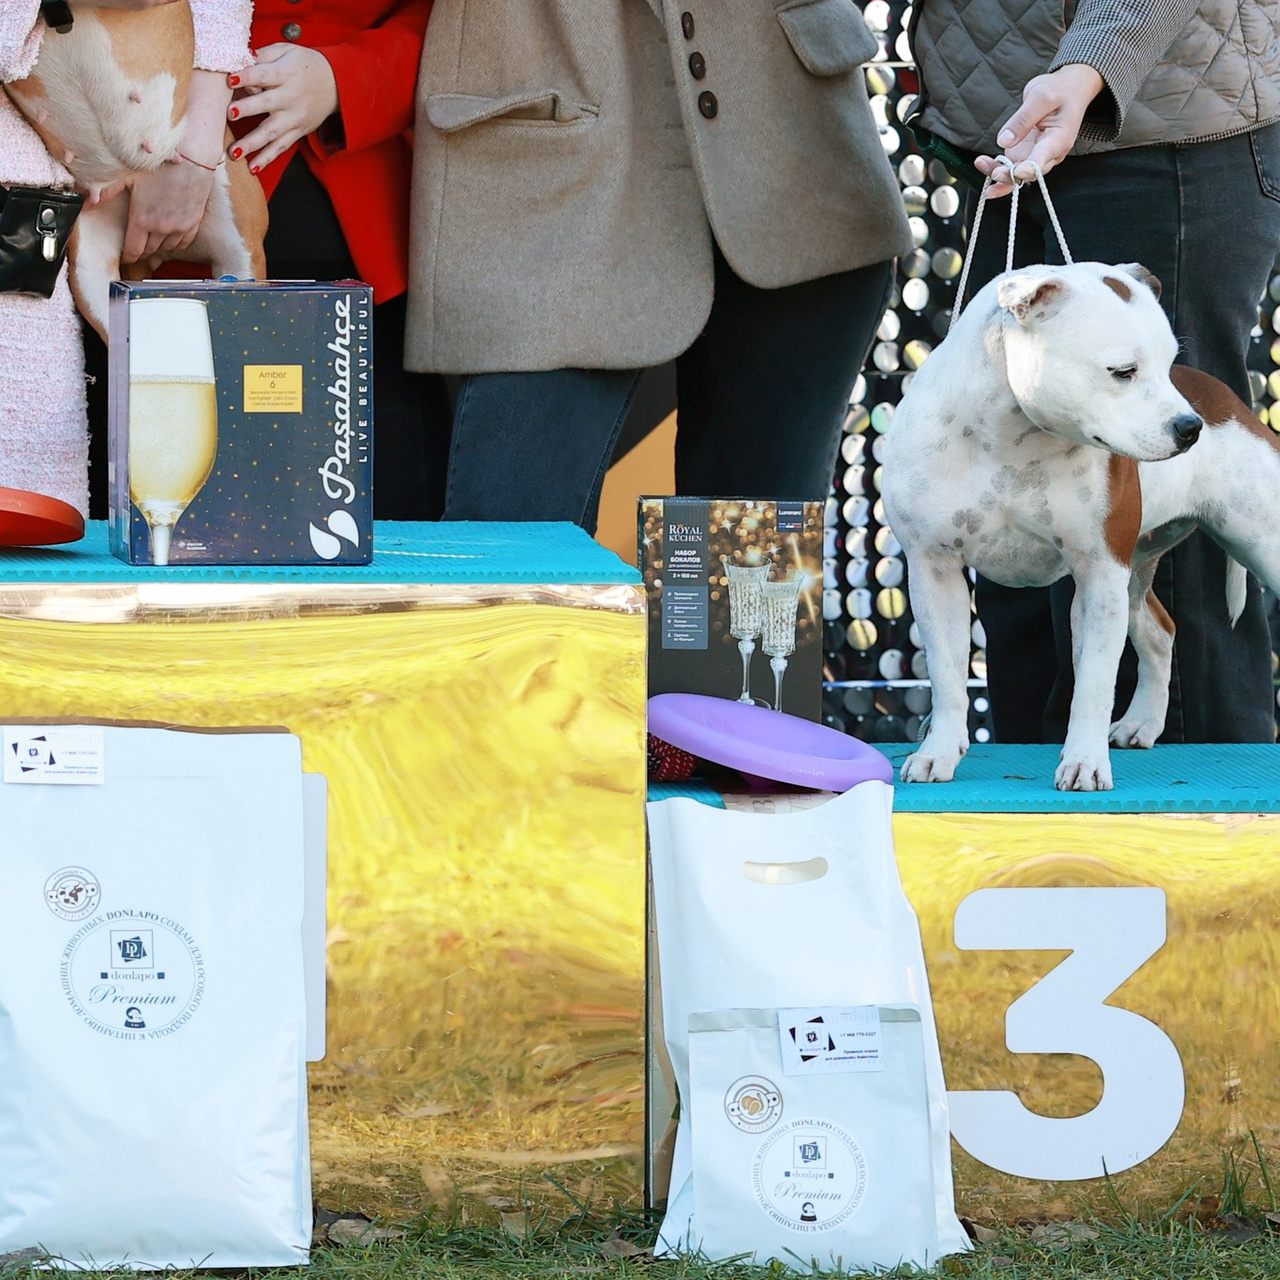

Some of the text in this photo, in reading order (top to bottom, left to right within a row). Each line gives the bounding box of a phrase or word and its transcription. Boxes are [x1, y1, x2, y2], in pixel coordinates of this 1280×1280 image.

[259, 371, 287, 379] Amber
[358, 297, 368, 463] LIVE BEAUTIFUL
[269, 380, 276, 389] 6
[669, 524, 703, 535] ROYAL
[669, 534, 702, 542] KÜCHEN
[60, 909, 206, 1041] DONLAPO СОЗДАН ДЛЯ ОСОБОГО ПОДХОДА К ПИТАНИЮ ДОМАШНИХ ЖИВОТНЫХ
[111, 971, 155, 982] donlapo
[88, 984, 177, 1005] Premium
[947, 887, 1186, 1181] 3
[791, 1119, 833, 1130] DONLAPO
[792, 1170, 826, 1180] donlapo
[774, 1181, 842, 1201] Premium
